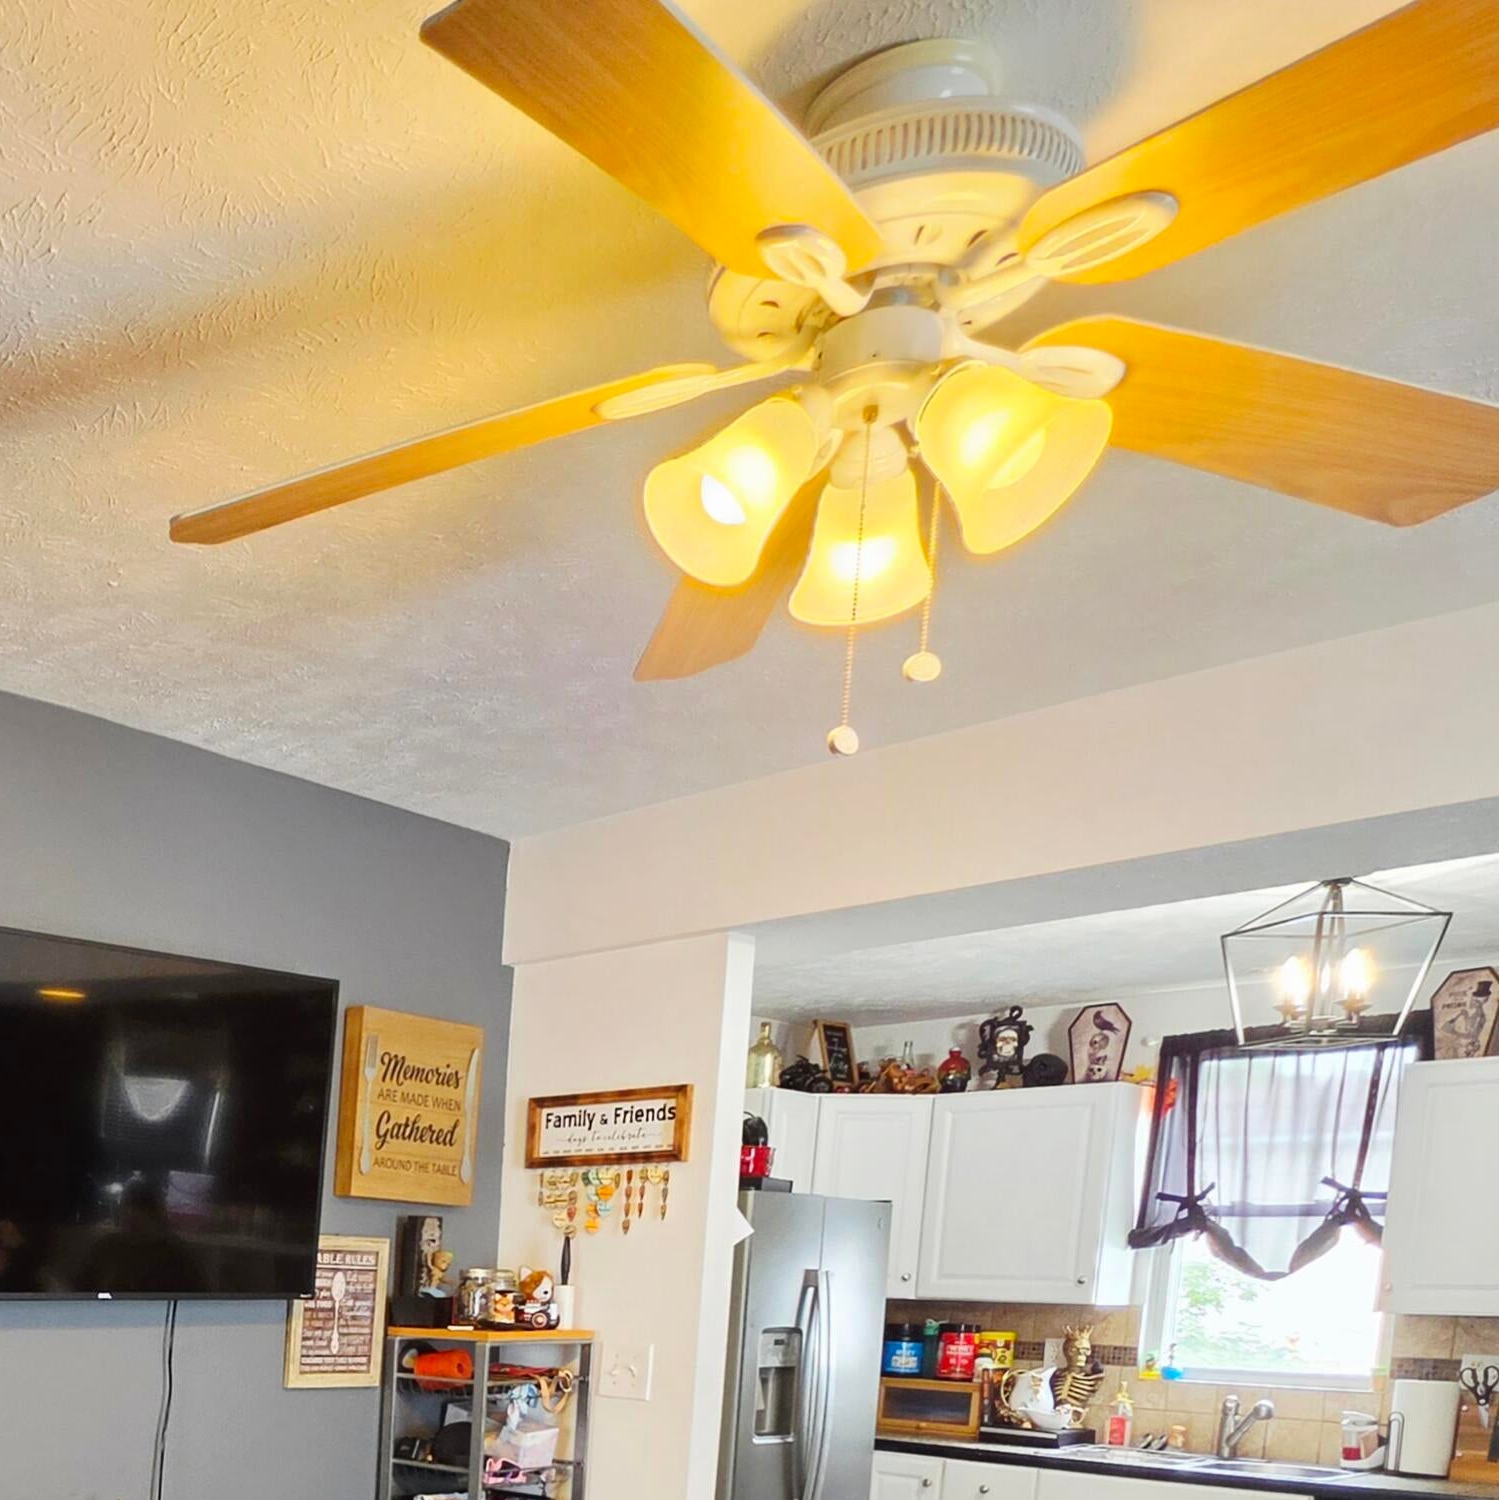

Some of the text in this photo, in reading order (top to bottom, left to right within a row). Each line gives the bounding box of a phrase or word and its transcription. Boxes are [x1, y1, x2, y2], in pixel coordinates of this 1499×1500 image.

[379, 1051, 464, 1090] Memories
[376, 1088, 461, 1112] ARE MADE WHEN
[374, 1109, 461, 1151] Gathered
[545, 1104, 677, 1131] Family & Friends
[372, 1158, 458, 1177] AROUND THE TABLE
